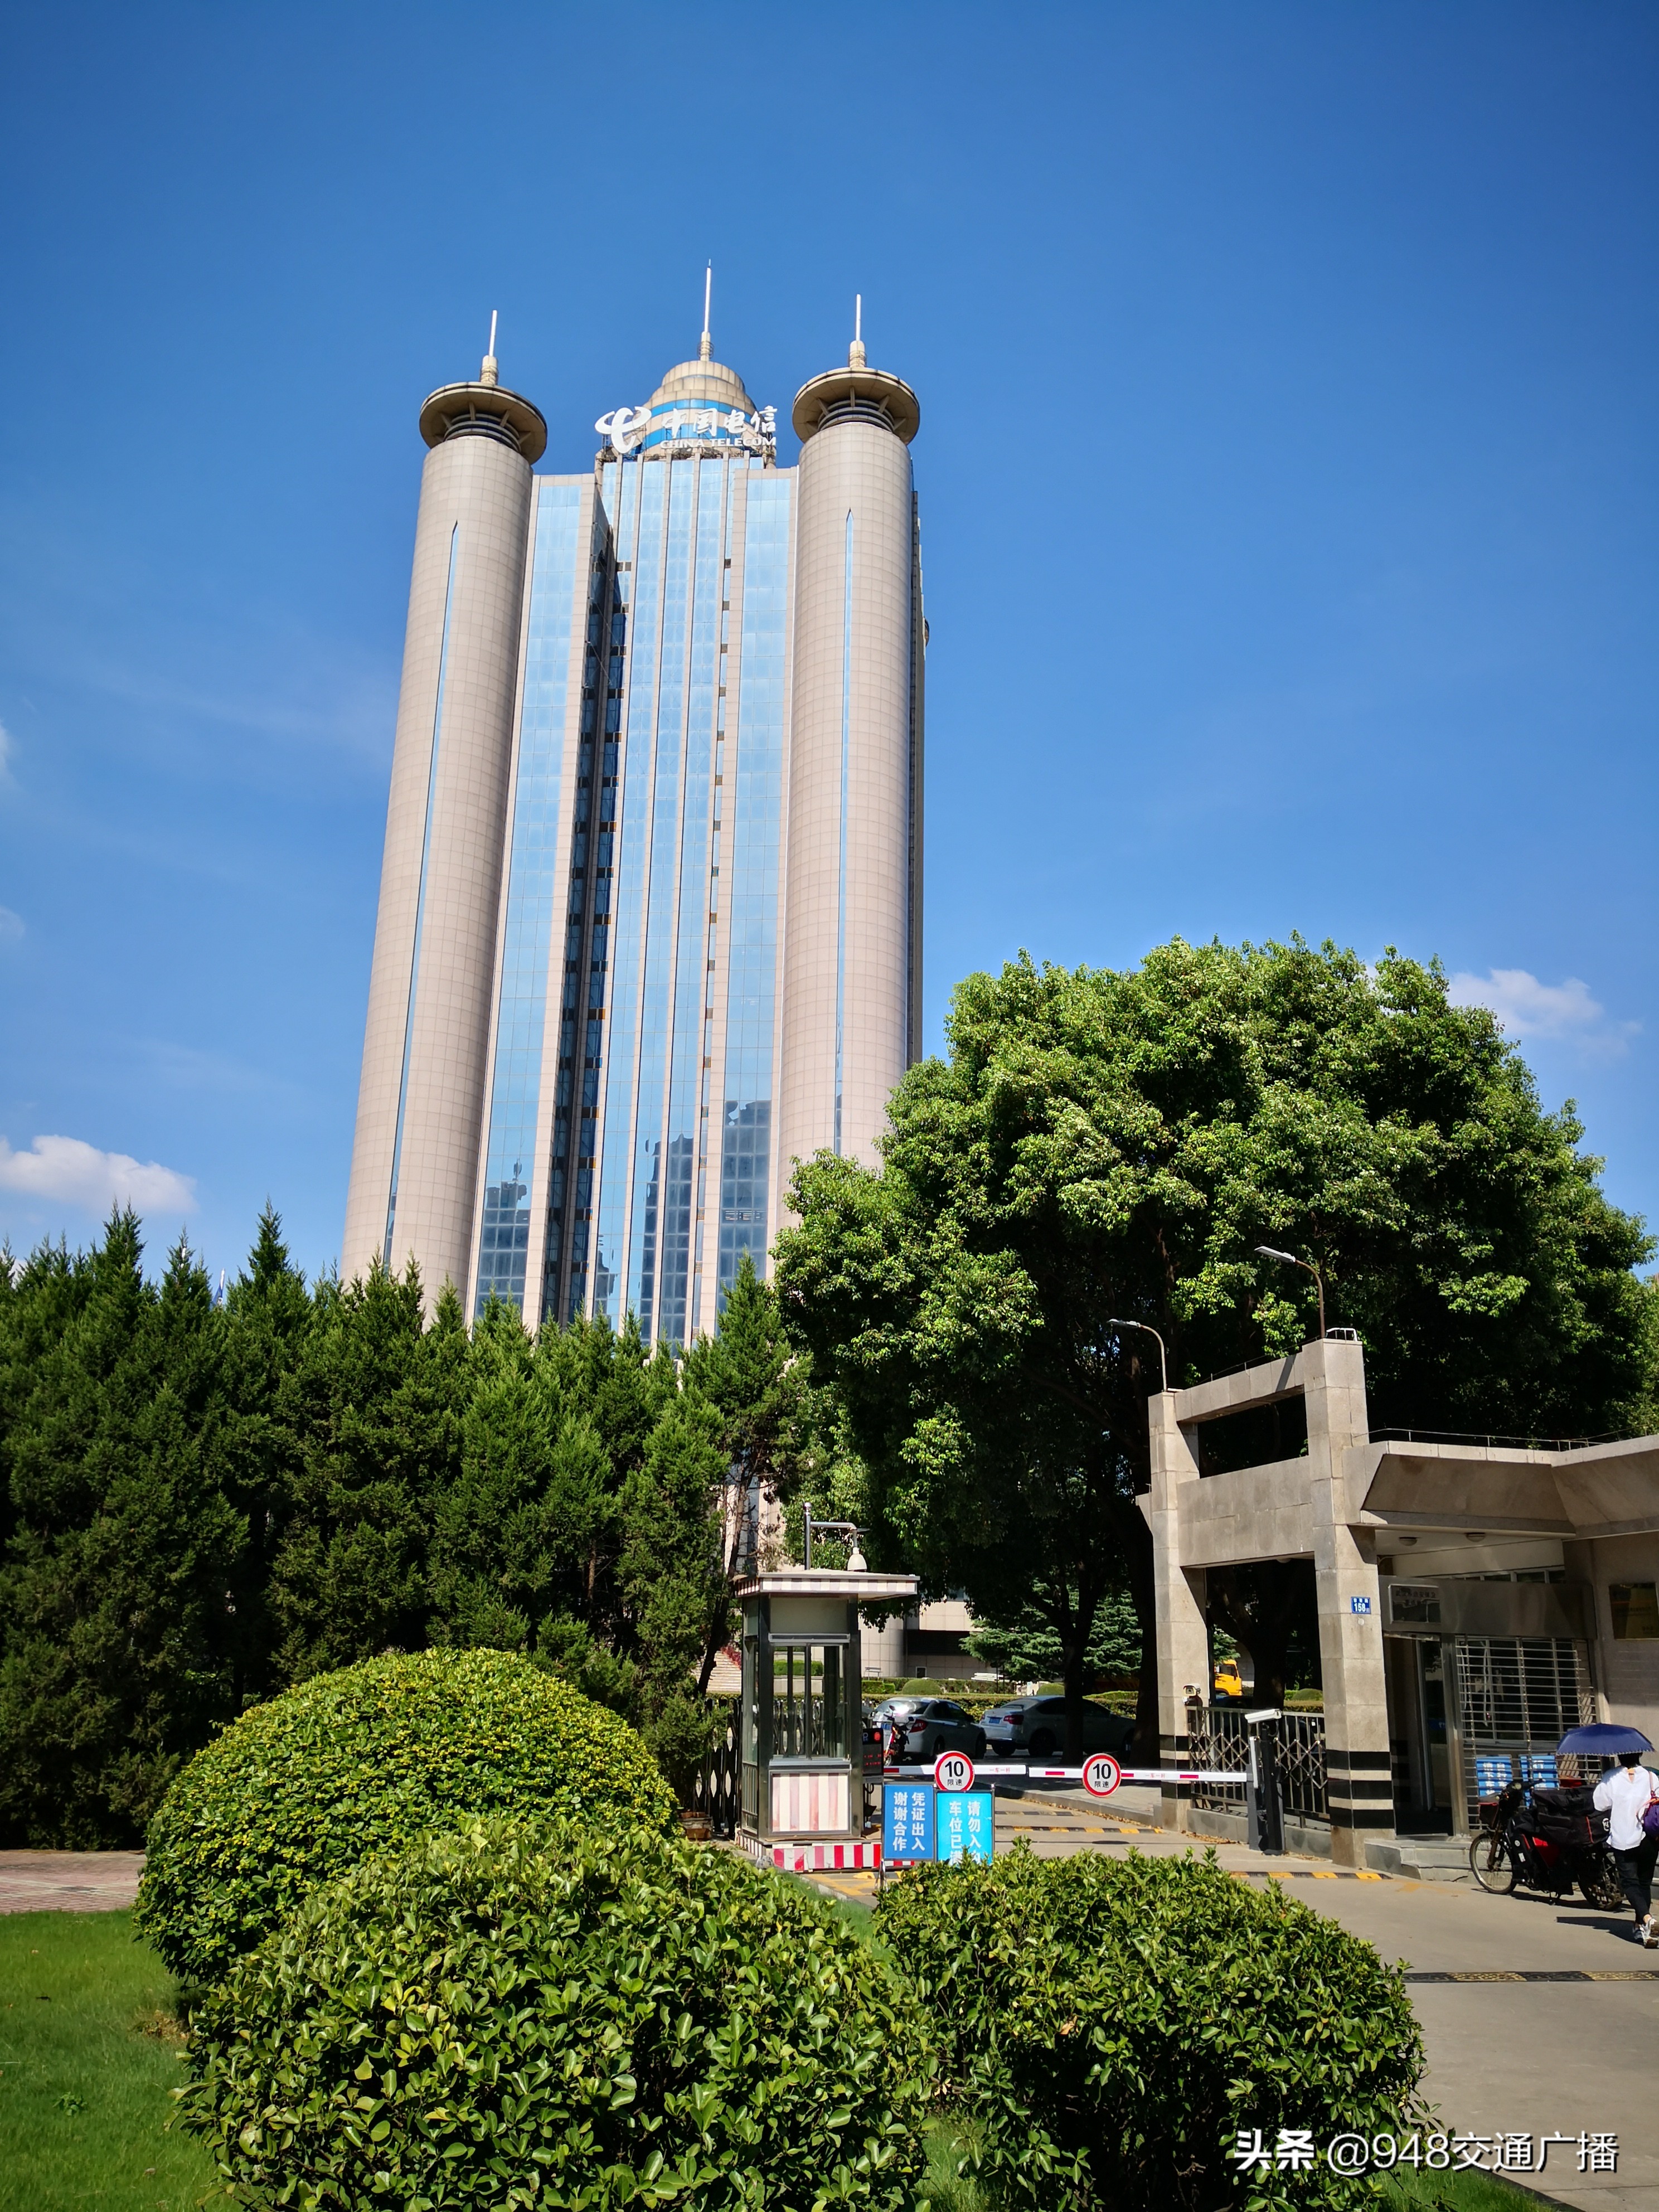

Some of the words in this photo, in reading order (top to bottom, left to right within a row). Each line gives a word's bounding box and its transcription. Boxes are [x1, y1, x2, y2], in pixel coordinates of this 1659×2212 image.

[662, 405, 778, 439] 中国电信
[660, 439, 705, 448] CHINA
[709, 436, 777, 447] TELECOM
[945, 1761, 964, 1777] 10
[1093, 1763, 1112, 1779] 10
[893, 1792, 908, 1851] 谢谢合作
[911, 1792, 925, 1851] 凭证出入
